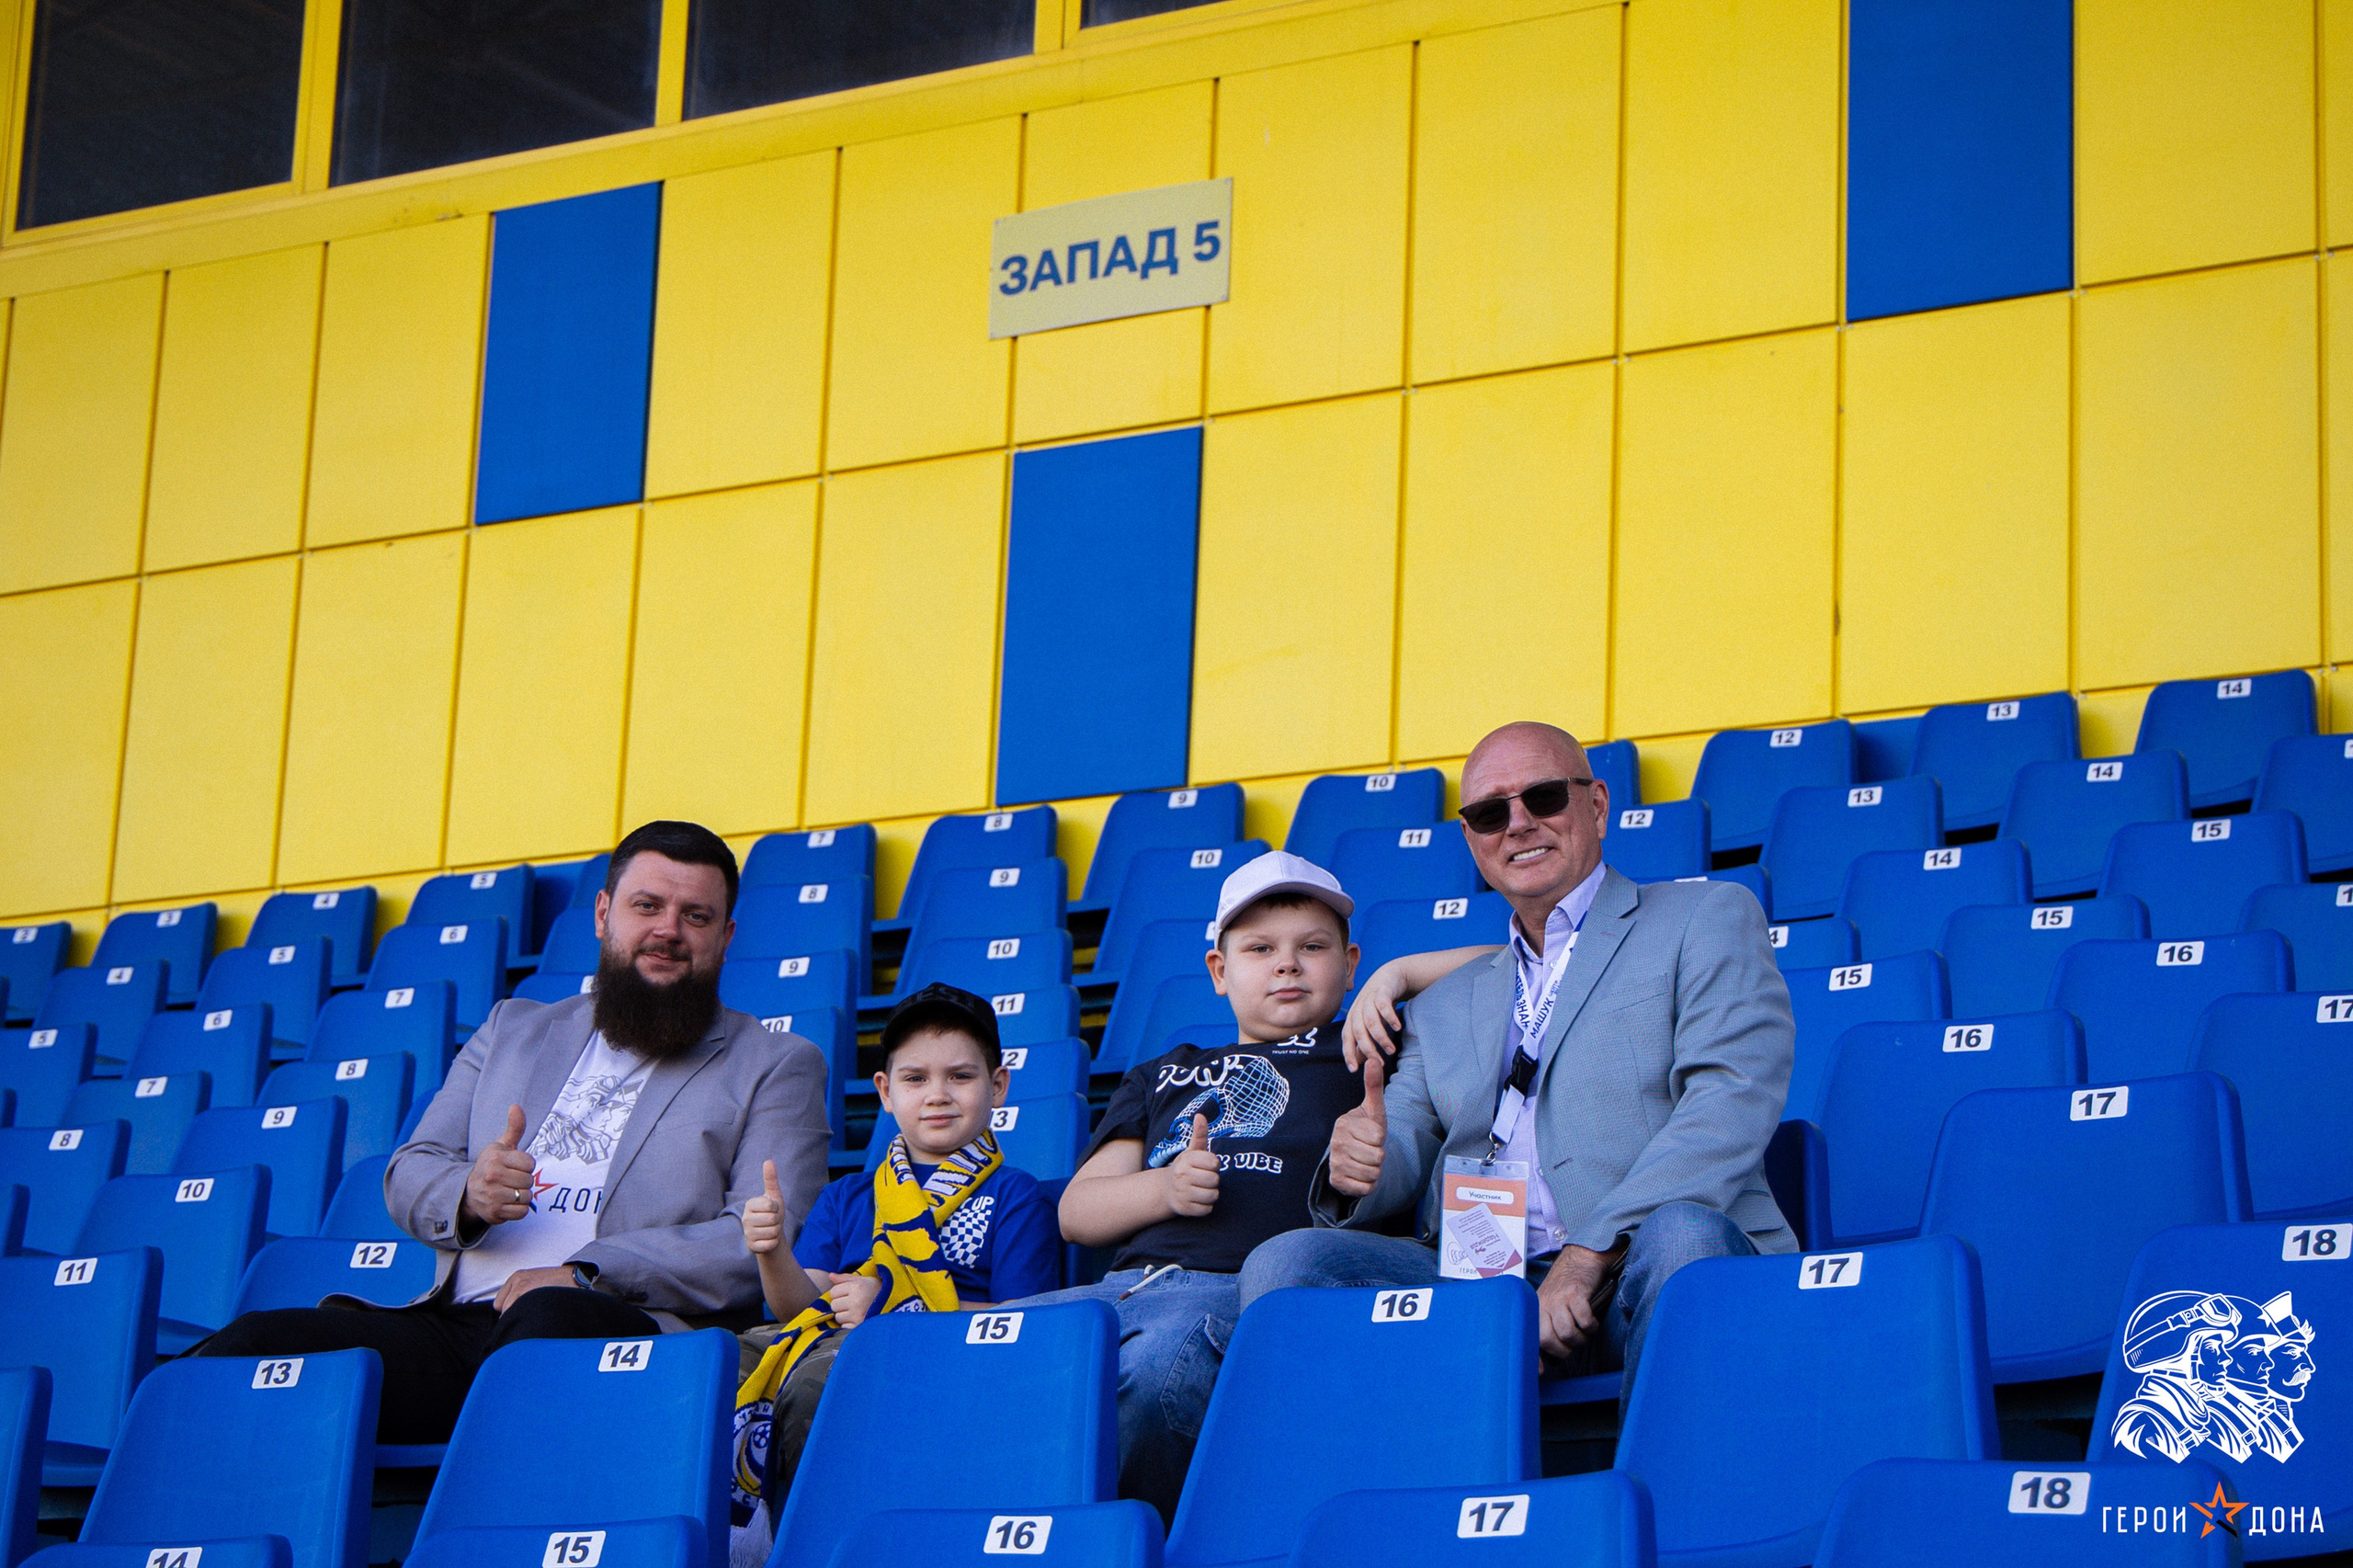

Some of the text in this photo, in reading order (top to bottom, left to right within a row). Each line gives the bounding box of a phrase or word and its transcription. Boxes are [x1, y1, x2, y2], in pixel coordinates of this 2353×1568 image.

[999, 219, 1221, 296] ЗАПАД 5
[2225, 681, 2244, 695] 14
[1995, 704, 2012, 717] 13
[1778, 731, 1795, 744] 12
[2094, 765, 2114, 778] 14
[1372, 777, 1389, 788] 10
[1856, 790, 1874, 803] 13
[1627, 812, 1646, 825] 12
[1408, 832, 1423, 844] 11
[2198, 822, 2222, 838] 15
[1198, 851, 1215, 864] 10
[1930, 850, 1952, 867] 14
[1439, 902, 1461, 915] 12
[2038, 910, 2063, 926] 15
[995, 941, 1013, 955] 10
[2164, 945, 2193, 962] 16
[1836, 968, 1862, 986] 15
[997, 996, 1016, 1012] 11
[2325, 999, 2353, 1018] 17
[1530, 997, 1554, 1039] МАШУК
[1950, 1028, 1983, 1049] 16
[2078, 1091, 2117, 1117] 17
[183, 1181, 206, 1199] 10
[1468, 1190, 1502, 1200] Участник
[972, 1196, 995, 1210] UP
[2292, 1229, 2337, 1256] 18
[358, 1245, 388, 1265] 12
[63, 1261, 87, 1282] 11
[1808, 1256, 1850, 1285] 17
[1381, 1292, 1420, 1318] 16
[975, 1316, 1012, 1340] 15
[608, 1344, 641, 1368] 14
[261, 1361, 292, 1385] 13
[2021, 1476, 2073, 1509] 18
[1469, 1501, 1515, 1532] 17
[995, 1520, 1038, 1550] 16
[553, 1536, 593, 1564] 15
